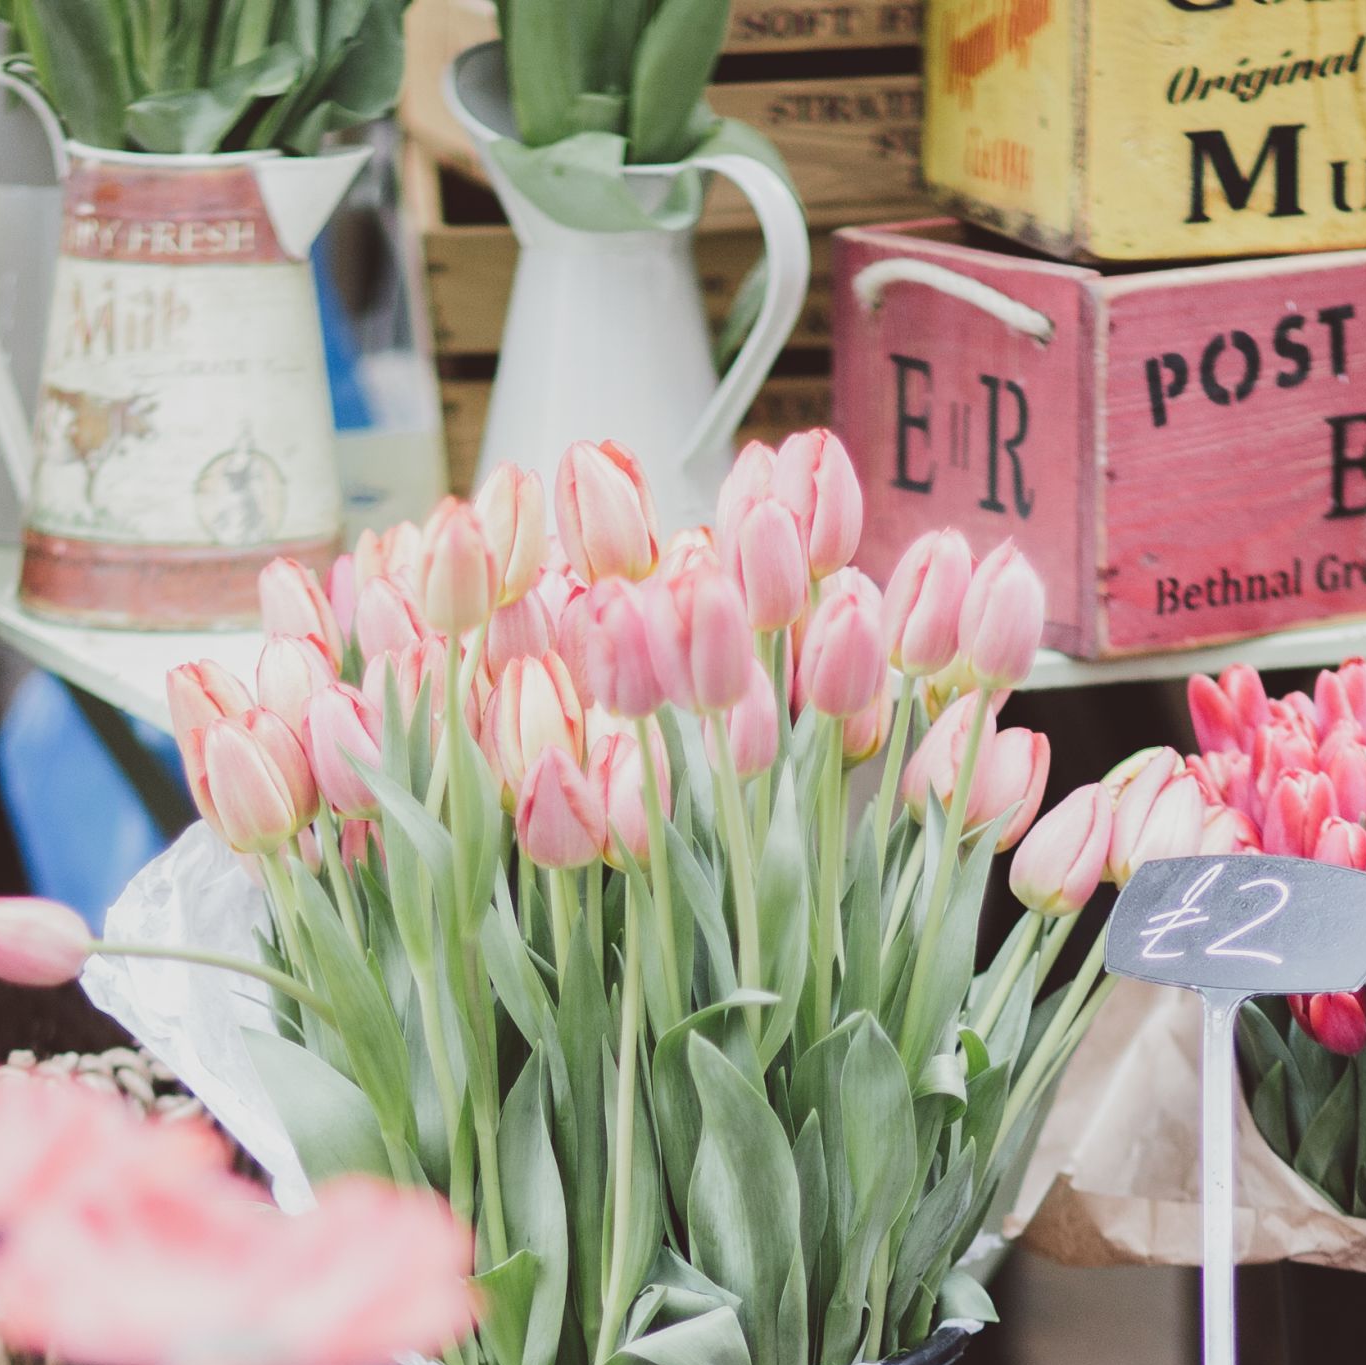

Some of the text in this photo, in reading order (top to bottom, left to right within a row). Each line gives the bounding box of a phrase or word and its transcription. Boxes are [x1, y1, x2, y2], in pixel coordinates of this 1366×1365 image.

[127, 218, 256, 254] FRESH
[1145, 303, 1356, 428] POST
[1155, 557, 1304, 617] Bethnal
[1139, 862, 1290, 965] £2
